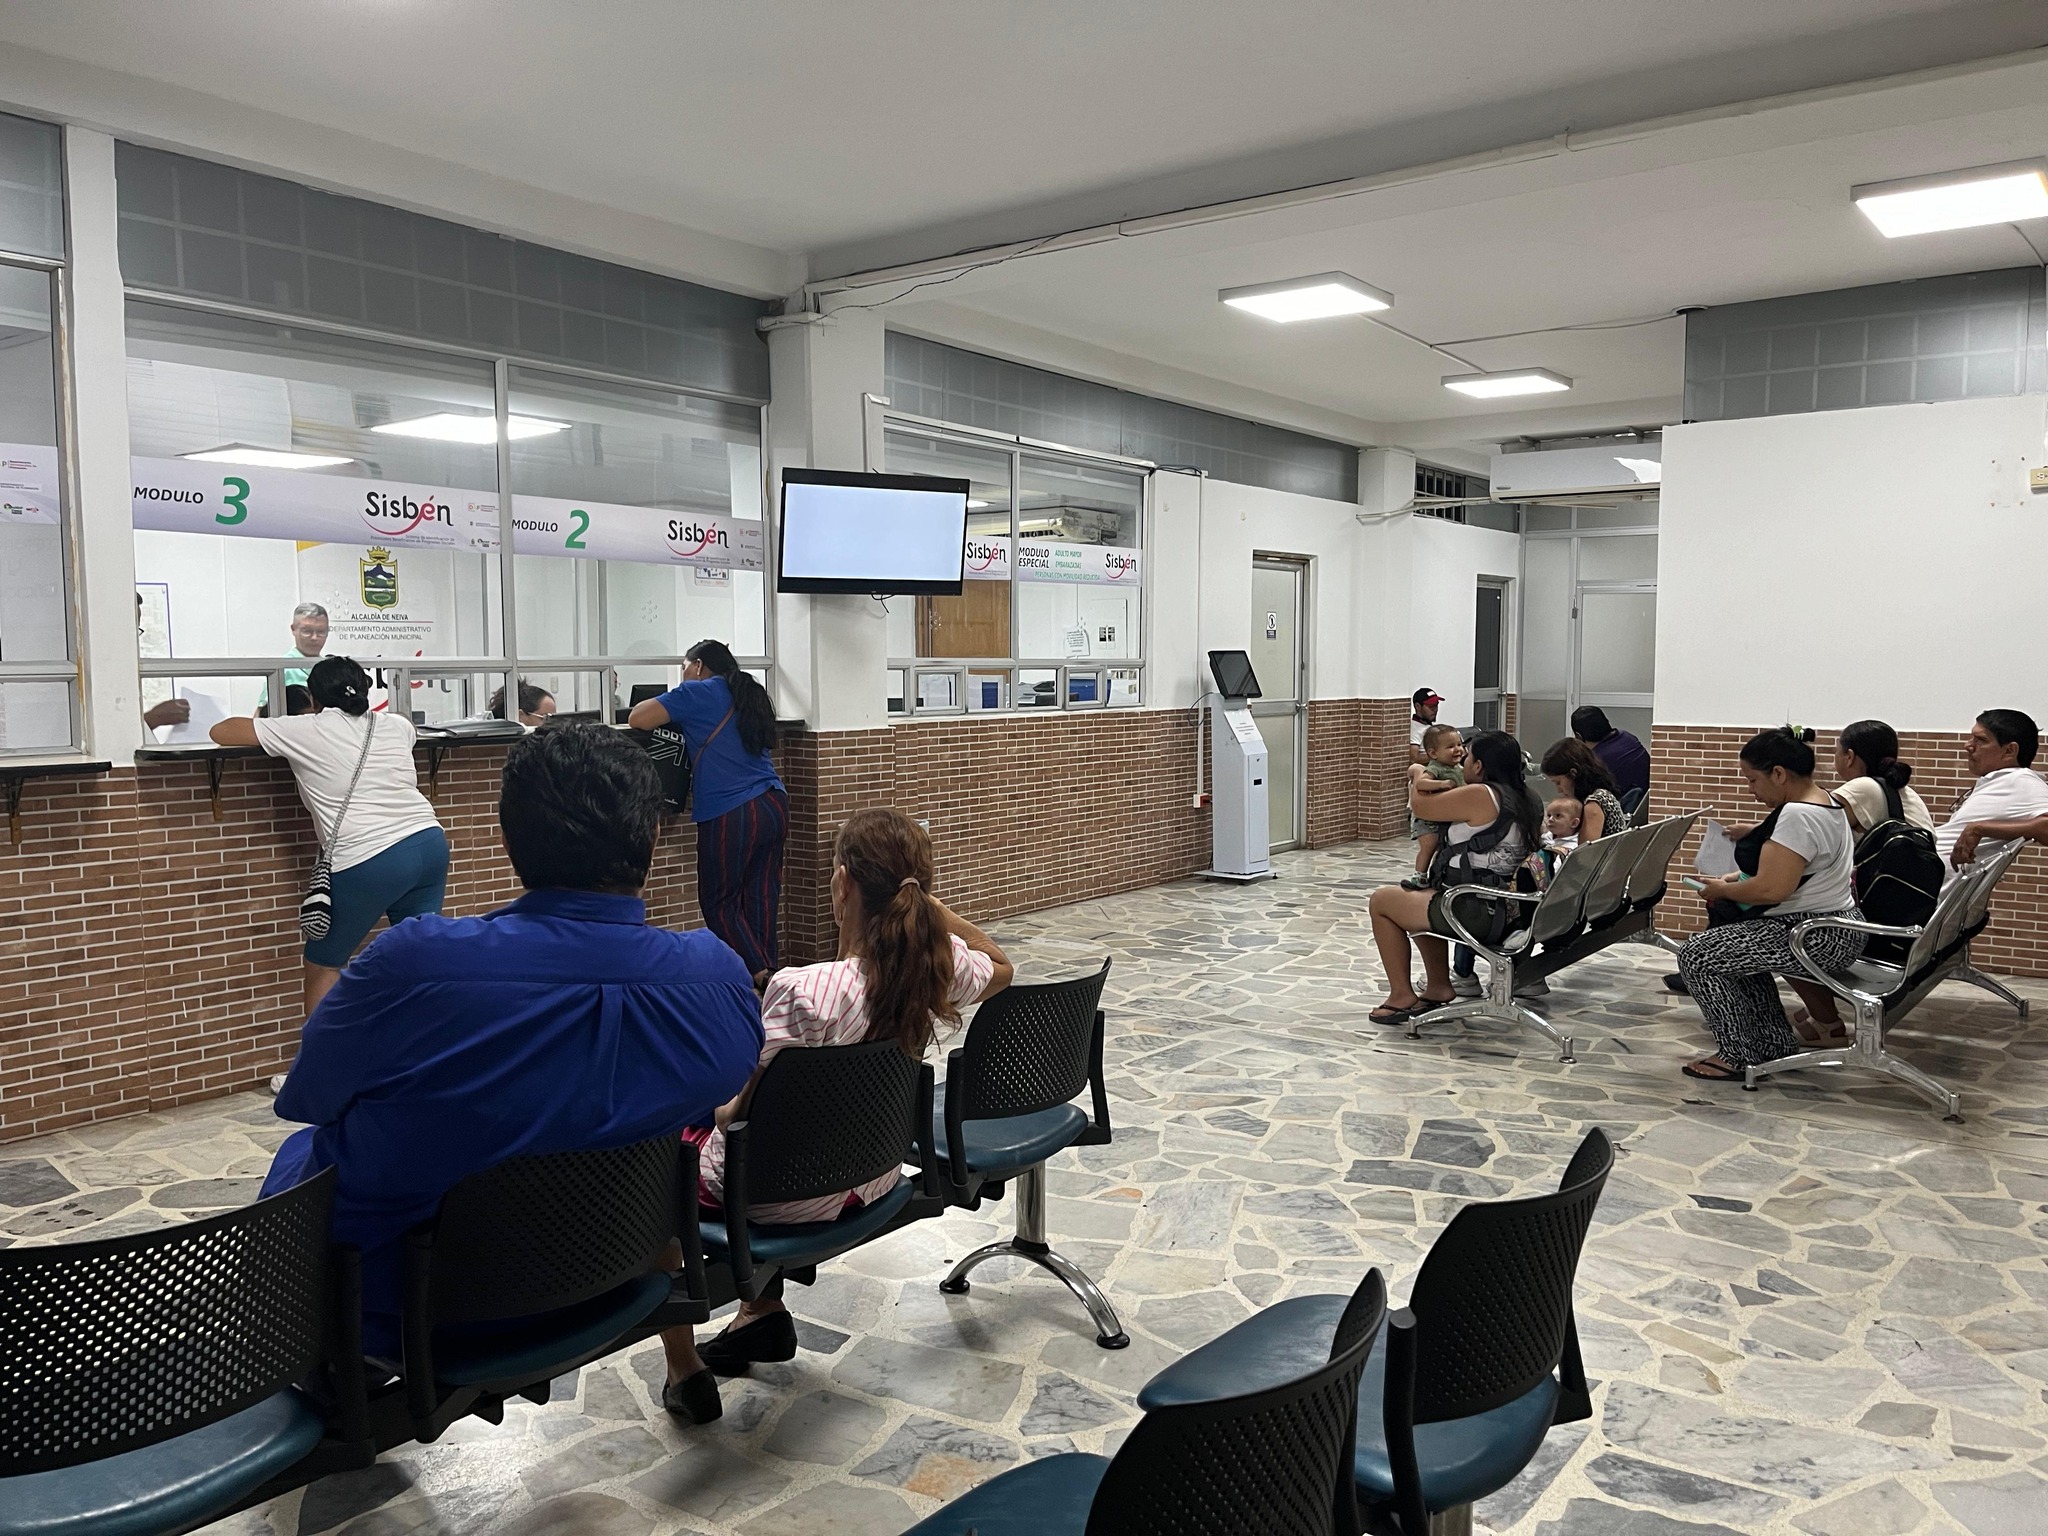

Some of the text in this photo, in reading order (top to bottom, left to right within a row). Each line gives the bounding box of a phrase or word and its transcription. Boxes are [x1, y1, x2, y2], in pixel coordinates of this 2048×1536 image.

[134, 476, 250, 526] MODULO 3
[364, 491, 454, 527] Sisbén
[511, 509, 590, 550] MODULO 2
[667, 519, 729, 549] Sisbén
[966, 541, 1007, 564] Sisbén
[1018, 547, 1050, 558] MODULO
[1018, 558, 1050, 568] ESPECIAL
[1105, 553, 1137, 572] Sisbén
[351, 612, 380, 620] ALCALDÍA
